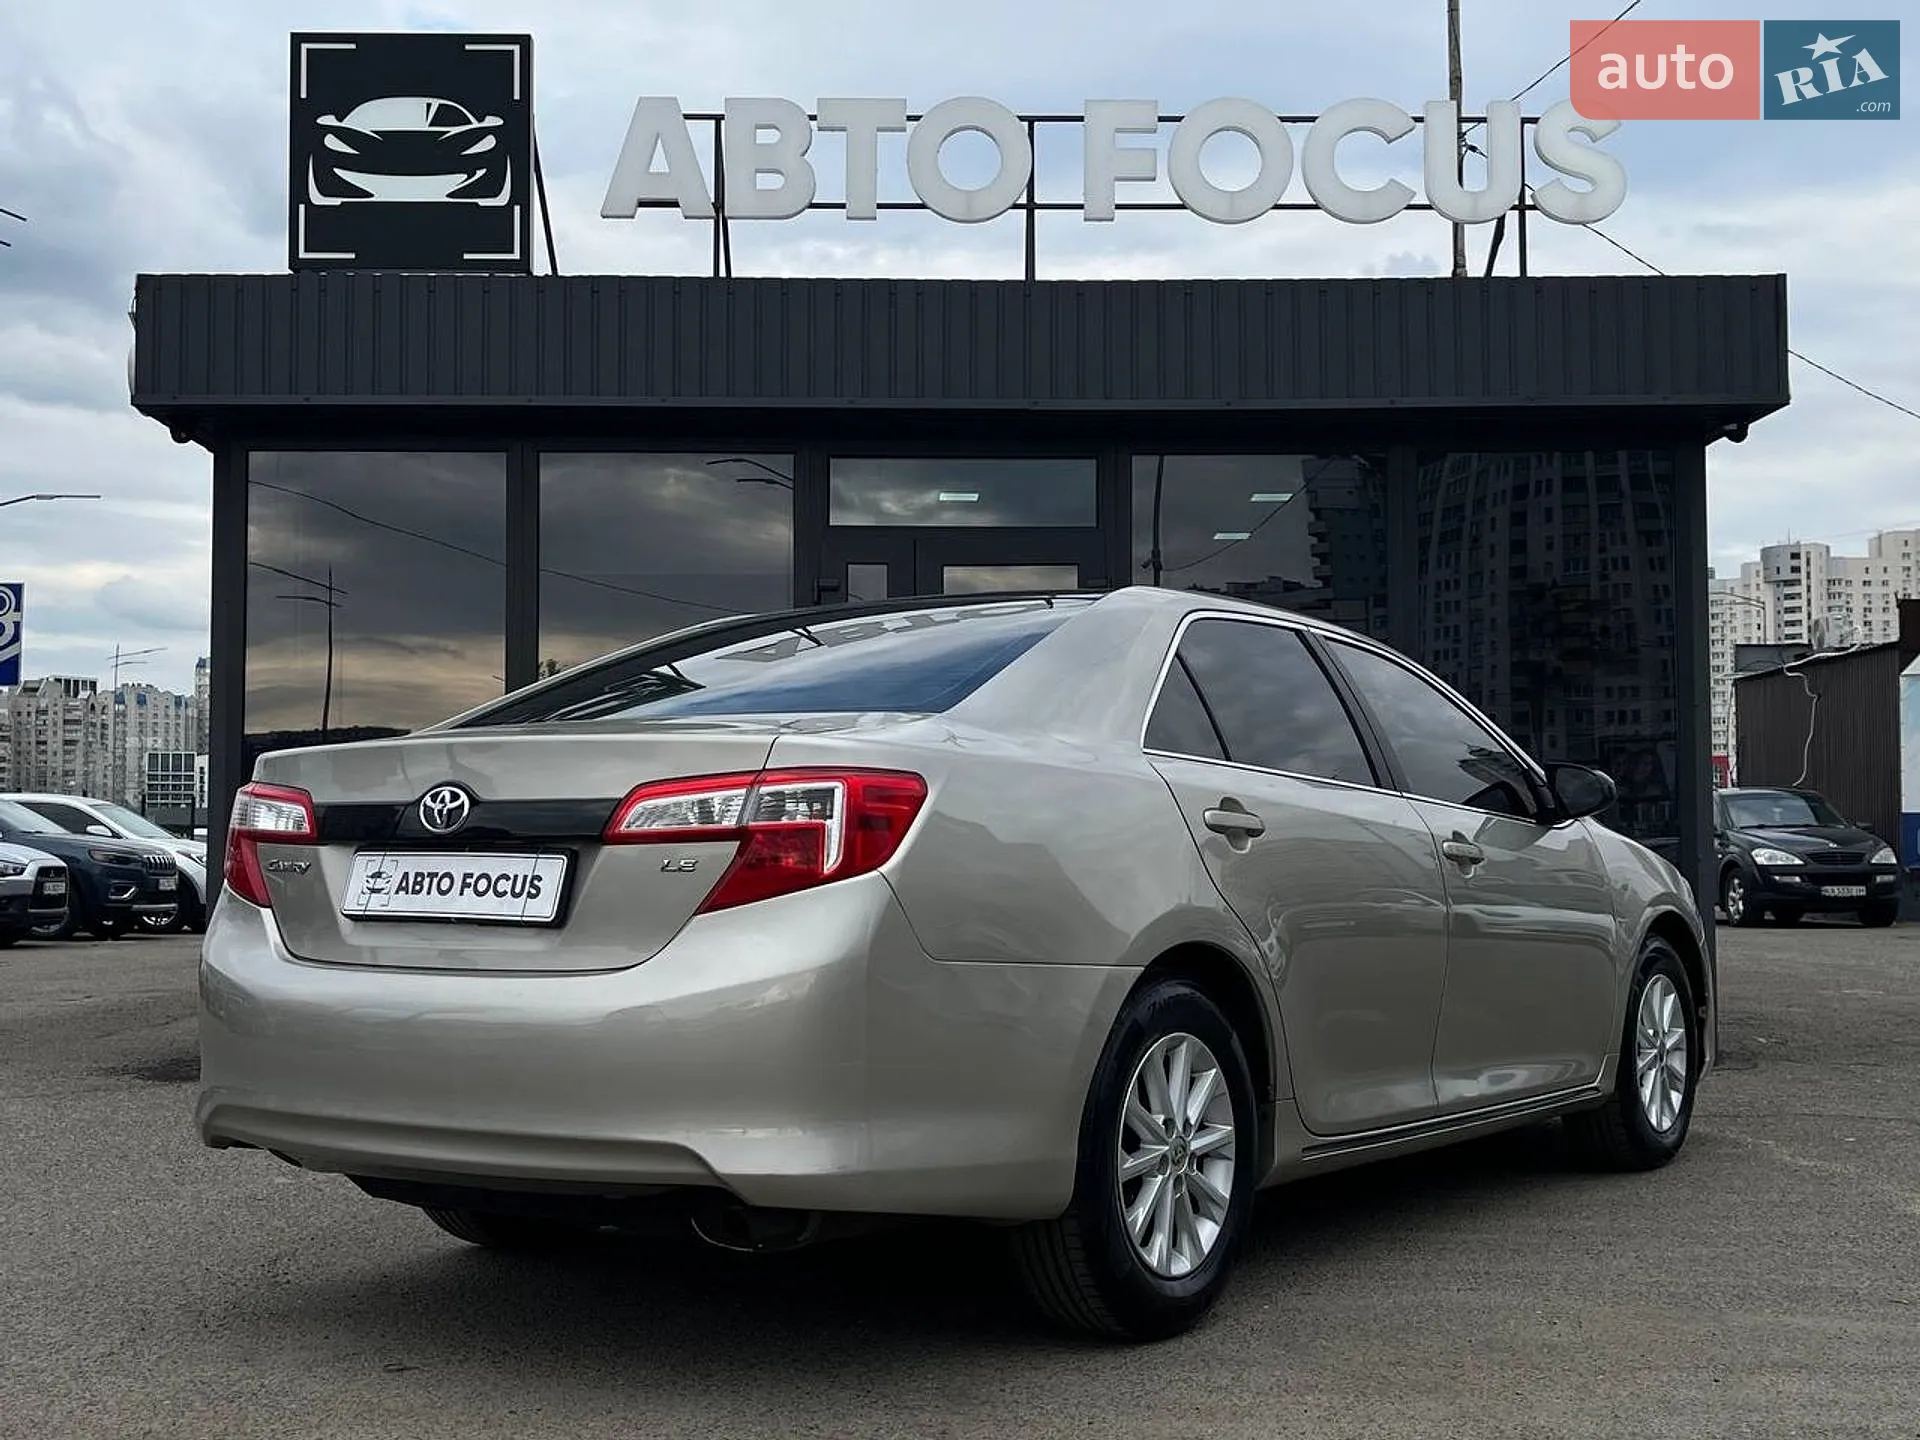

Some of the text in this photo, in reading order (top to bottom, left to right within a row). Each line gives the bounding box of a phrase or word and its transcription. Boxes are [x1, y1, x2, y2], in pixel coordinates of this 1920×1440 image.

[601, 97, 1628, 224] АВТО FOCUS
[660, 858, 699, 873] LE
[394, 870, 543, 900] АВТО FOCUS
